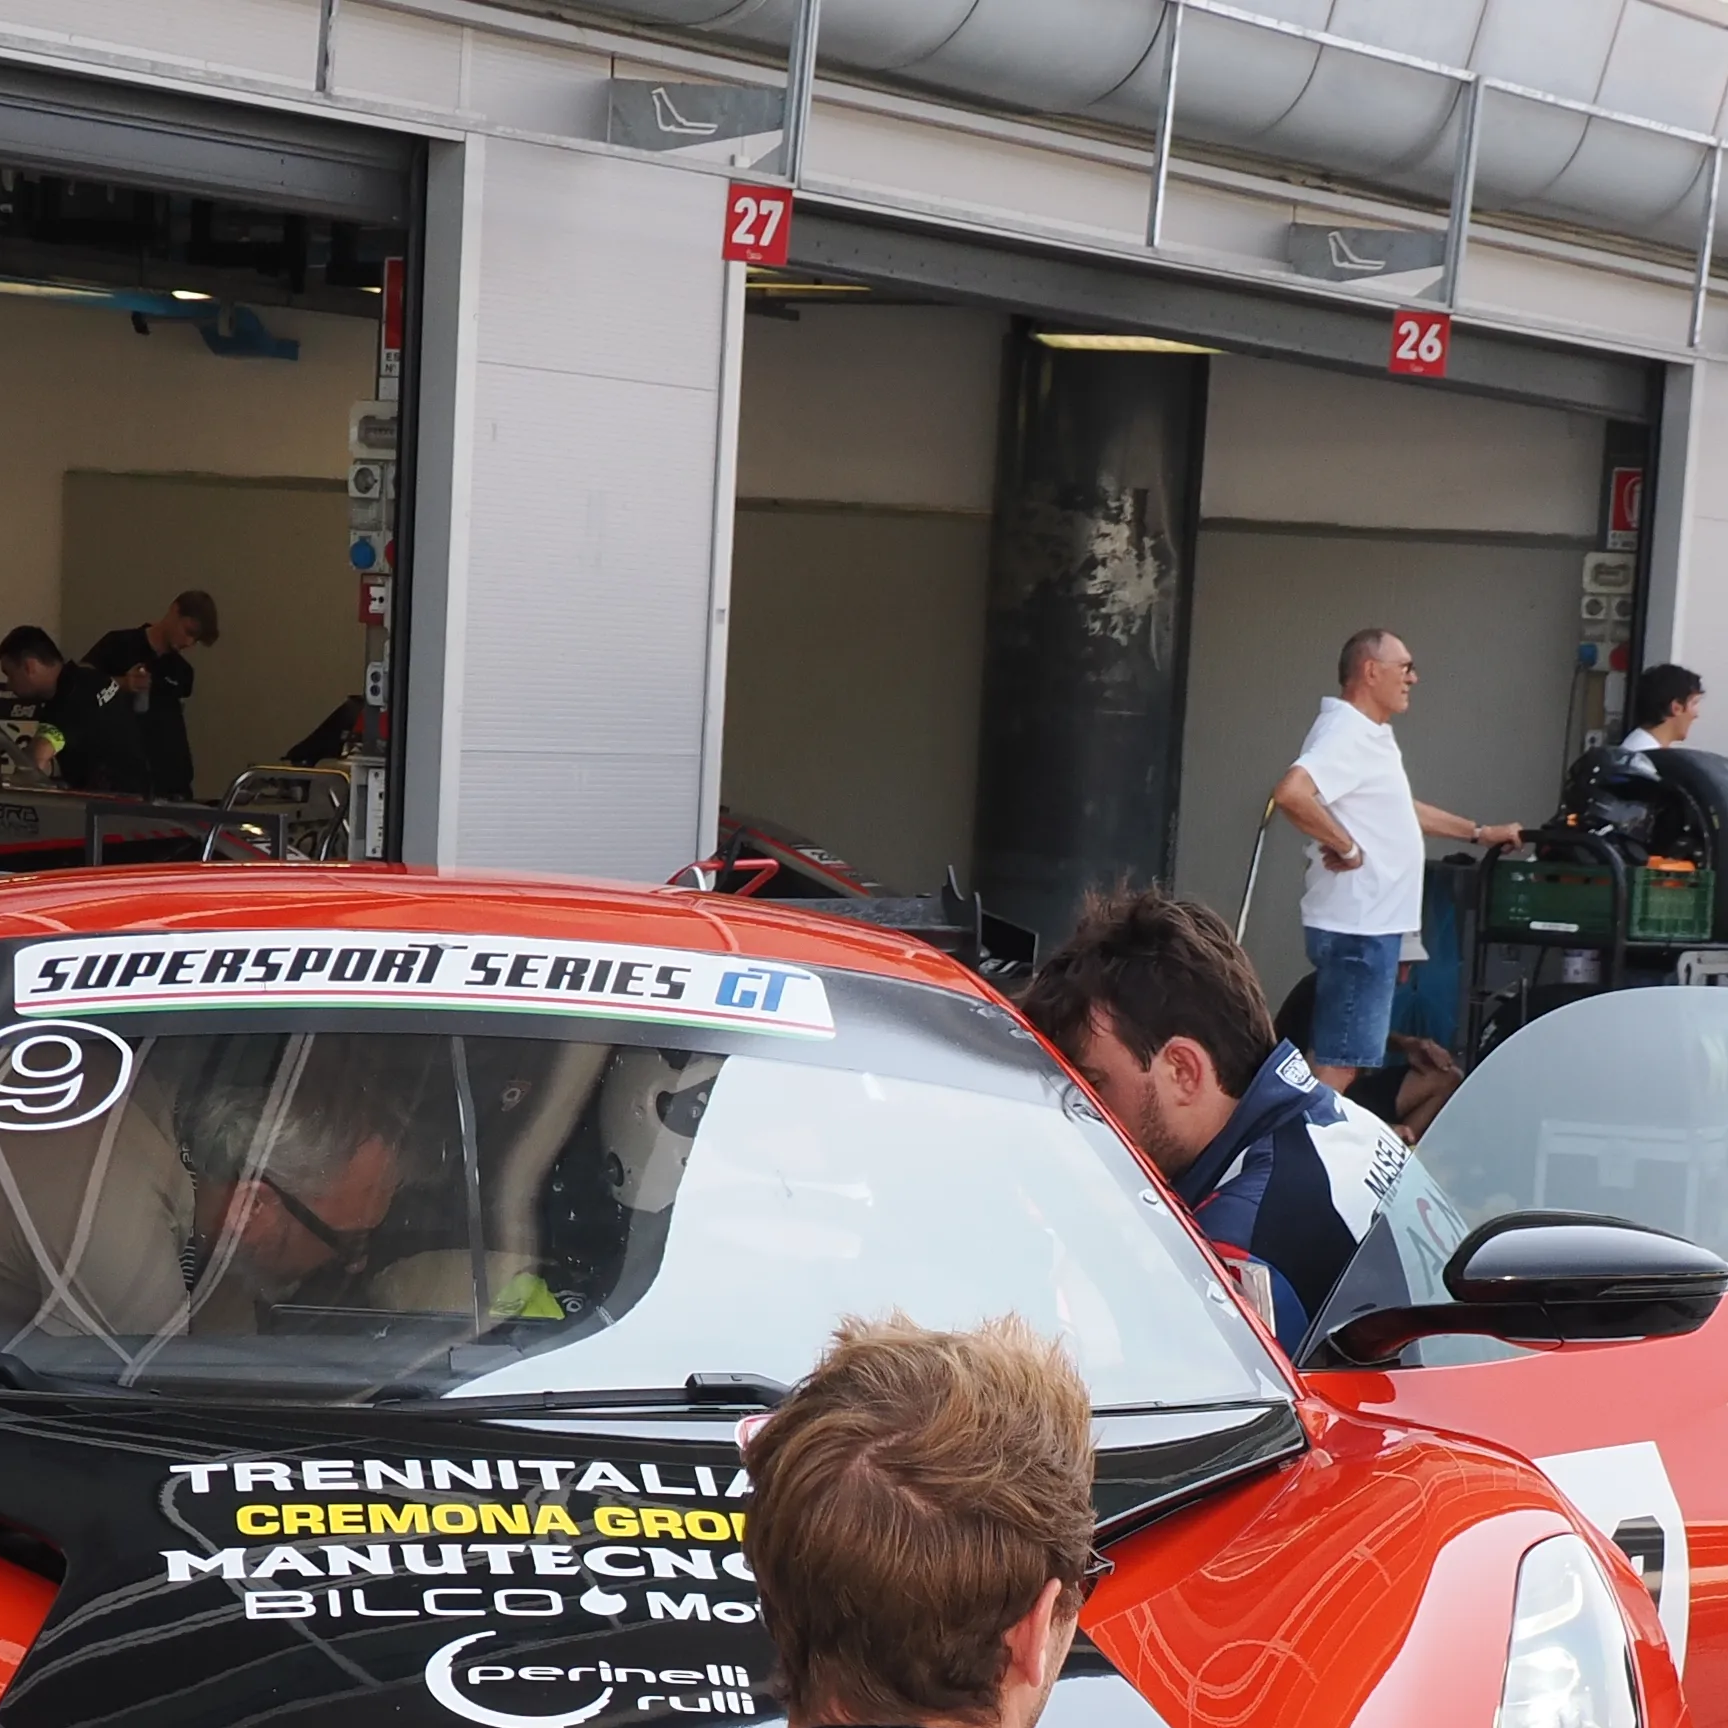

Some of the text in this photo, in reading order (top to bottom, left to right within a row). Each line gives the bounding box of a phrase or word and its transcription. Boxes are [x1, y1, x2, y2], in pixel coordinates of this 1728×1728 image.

[732, 197, 783, 245] 27
[1396, 320, 1442, 363] 26
[32, 943, 809, 1011] SUPERSPORT SERIES GT
[236, 1503, 581, 1537] CREMONA
[245, 1589, 760, 1623] BILCO Mo
[468, 1659, 751, 1690] perinelli
[637, 1689, 755, 1714] rulli
